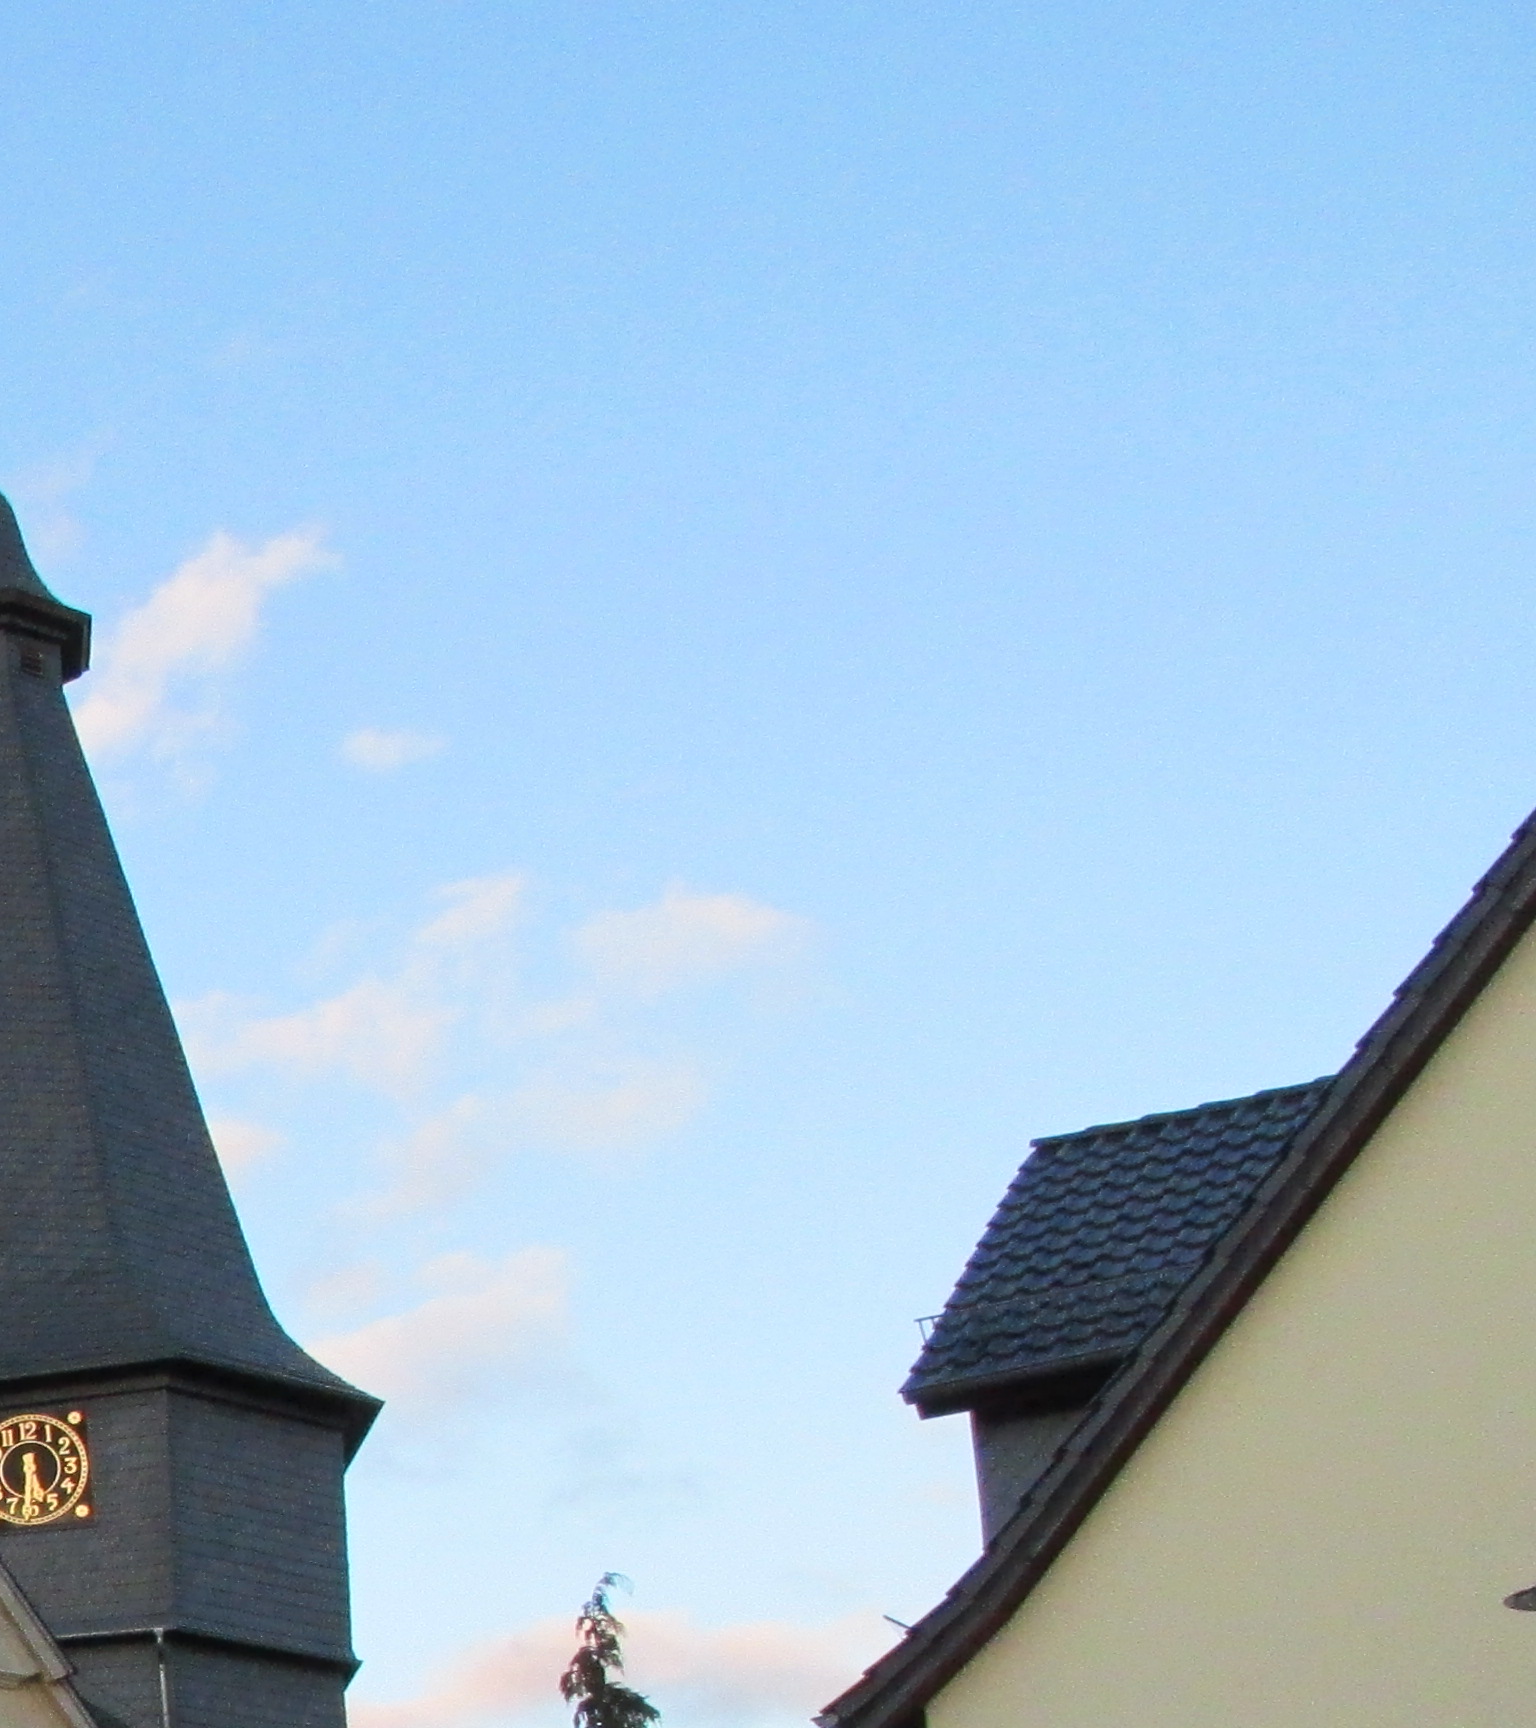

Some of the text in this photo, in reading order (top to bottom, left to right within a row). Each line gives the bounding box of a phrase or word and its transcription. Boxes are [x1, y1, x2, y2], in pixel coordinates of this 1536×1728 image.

[1, 1429, 14, 1447] 11
[19, 1421, 37, 1440] 12
[44, 1424, 52, 1442] 1
[58, 1436, 70, 1455] 2
[64, 1457, 77, 1474] 3
[60, 1477, 75, 1495] 4
[6, 1497, 19, 1515] 7
[46, 1493, 59, 1511] 5
